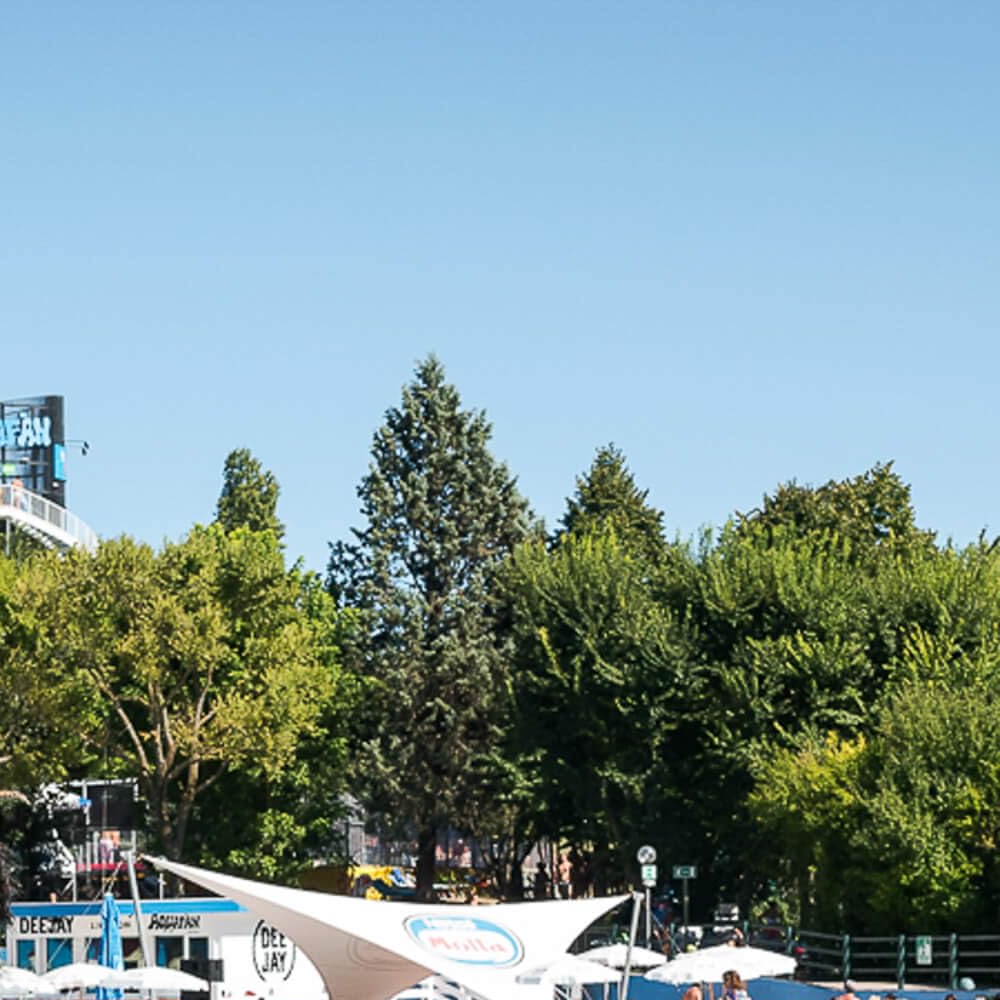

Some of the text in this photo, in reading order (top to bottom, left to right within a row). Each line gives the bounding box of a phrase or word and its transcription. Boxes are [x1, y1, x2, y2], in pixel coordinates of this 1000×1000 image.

[20, 916, 74, 933] DEEJAY
[261, 926, 287, 948] DEE
[262, 951, 287, 972] JAY
